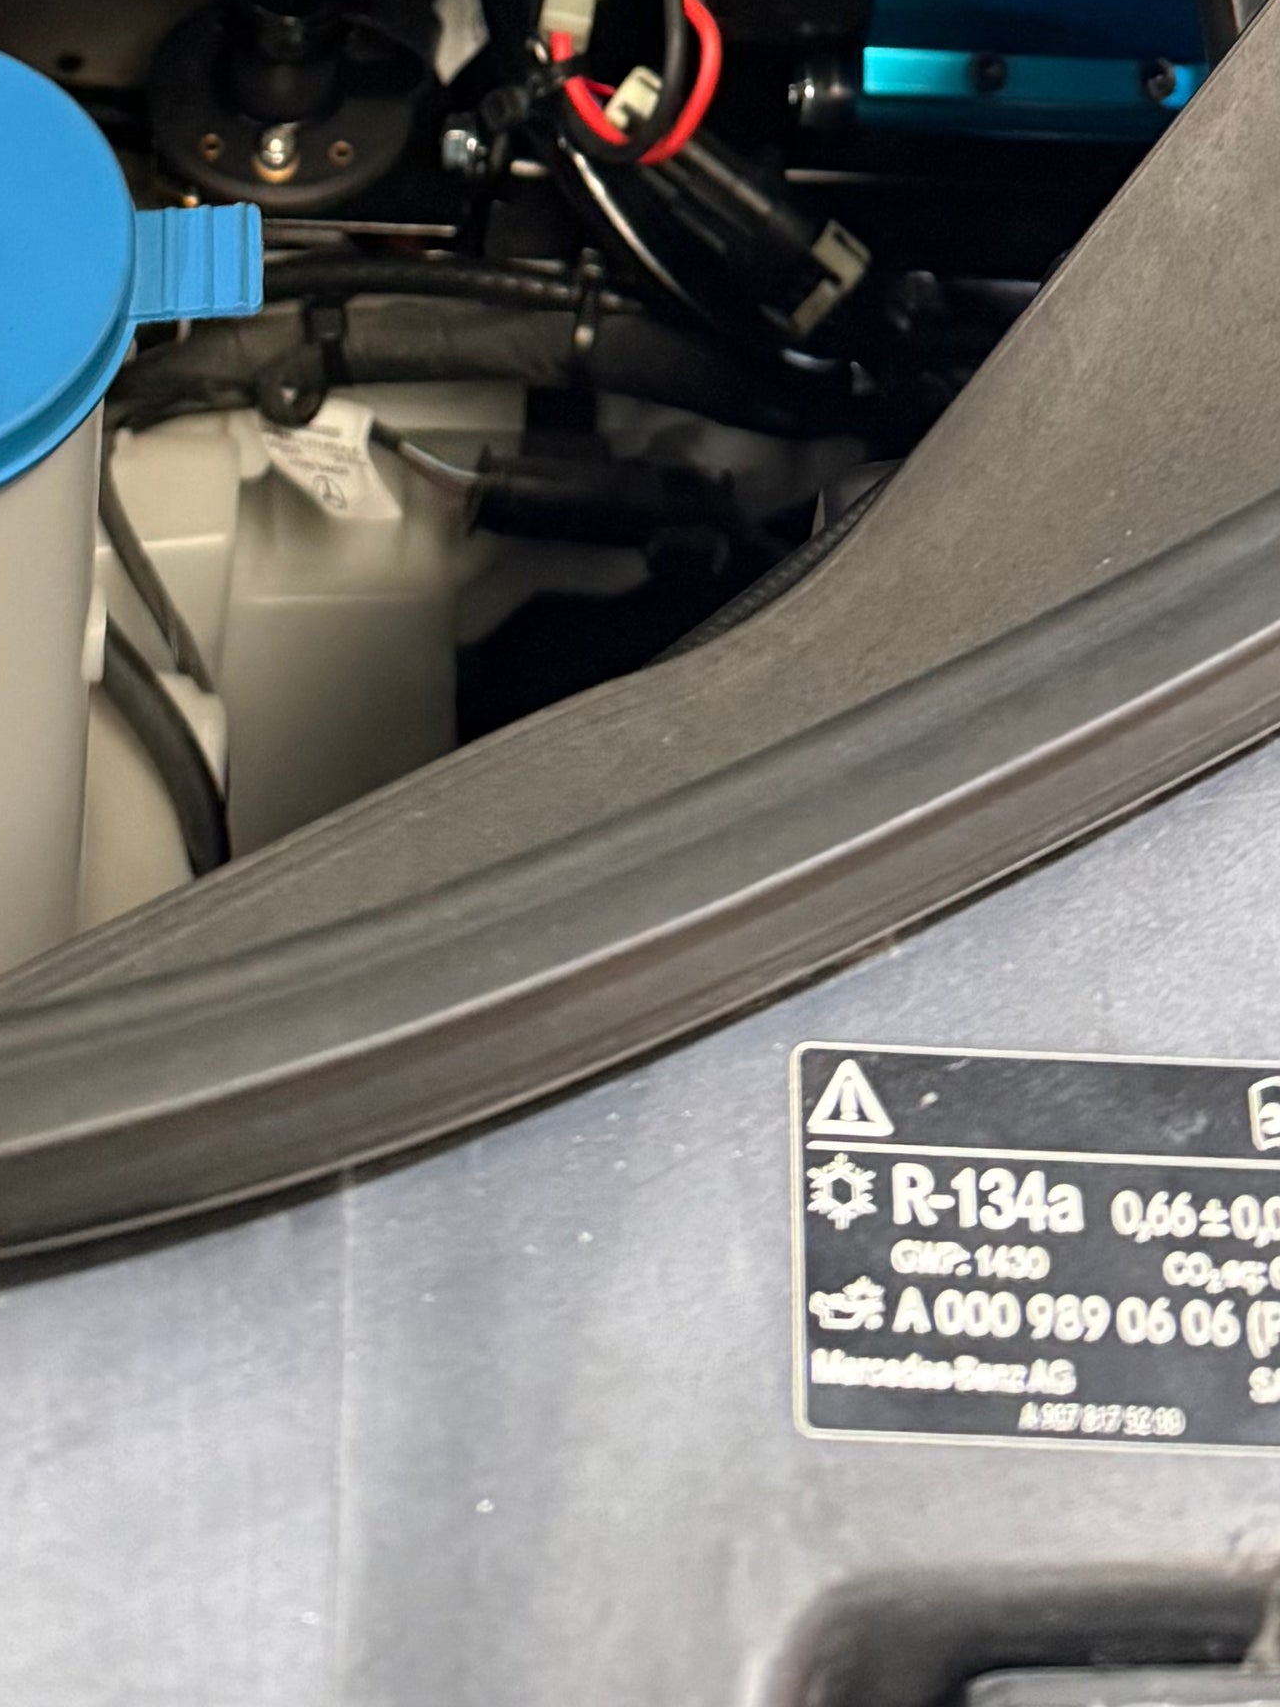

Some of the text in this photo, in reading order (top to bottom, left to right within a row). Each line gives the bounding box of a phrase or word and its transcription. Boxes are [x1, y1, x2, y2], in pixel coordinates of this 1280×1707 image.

[892, 1162, 1084, 1233] R-134a
[892, 1286, 931, 1333] A
[934, 1289, 1021, 1338] 000
[1026, 1293, 1110, 1342] 989
[1116, 1296, 1177, 1344] 06
[1181, 1298, 1241, 1347] 06
[1025, 1358, 1077, 1395] AG
